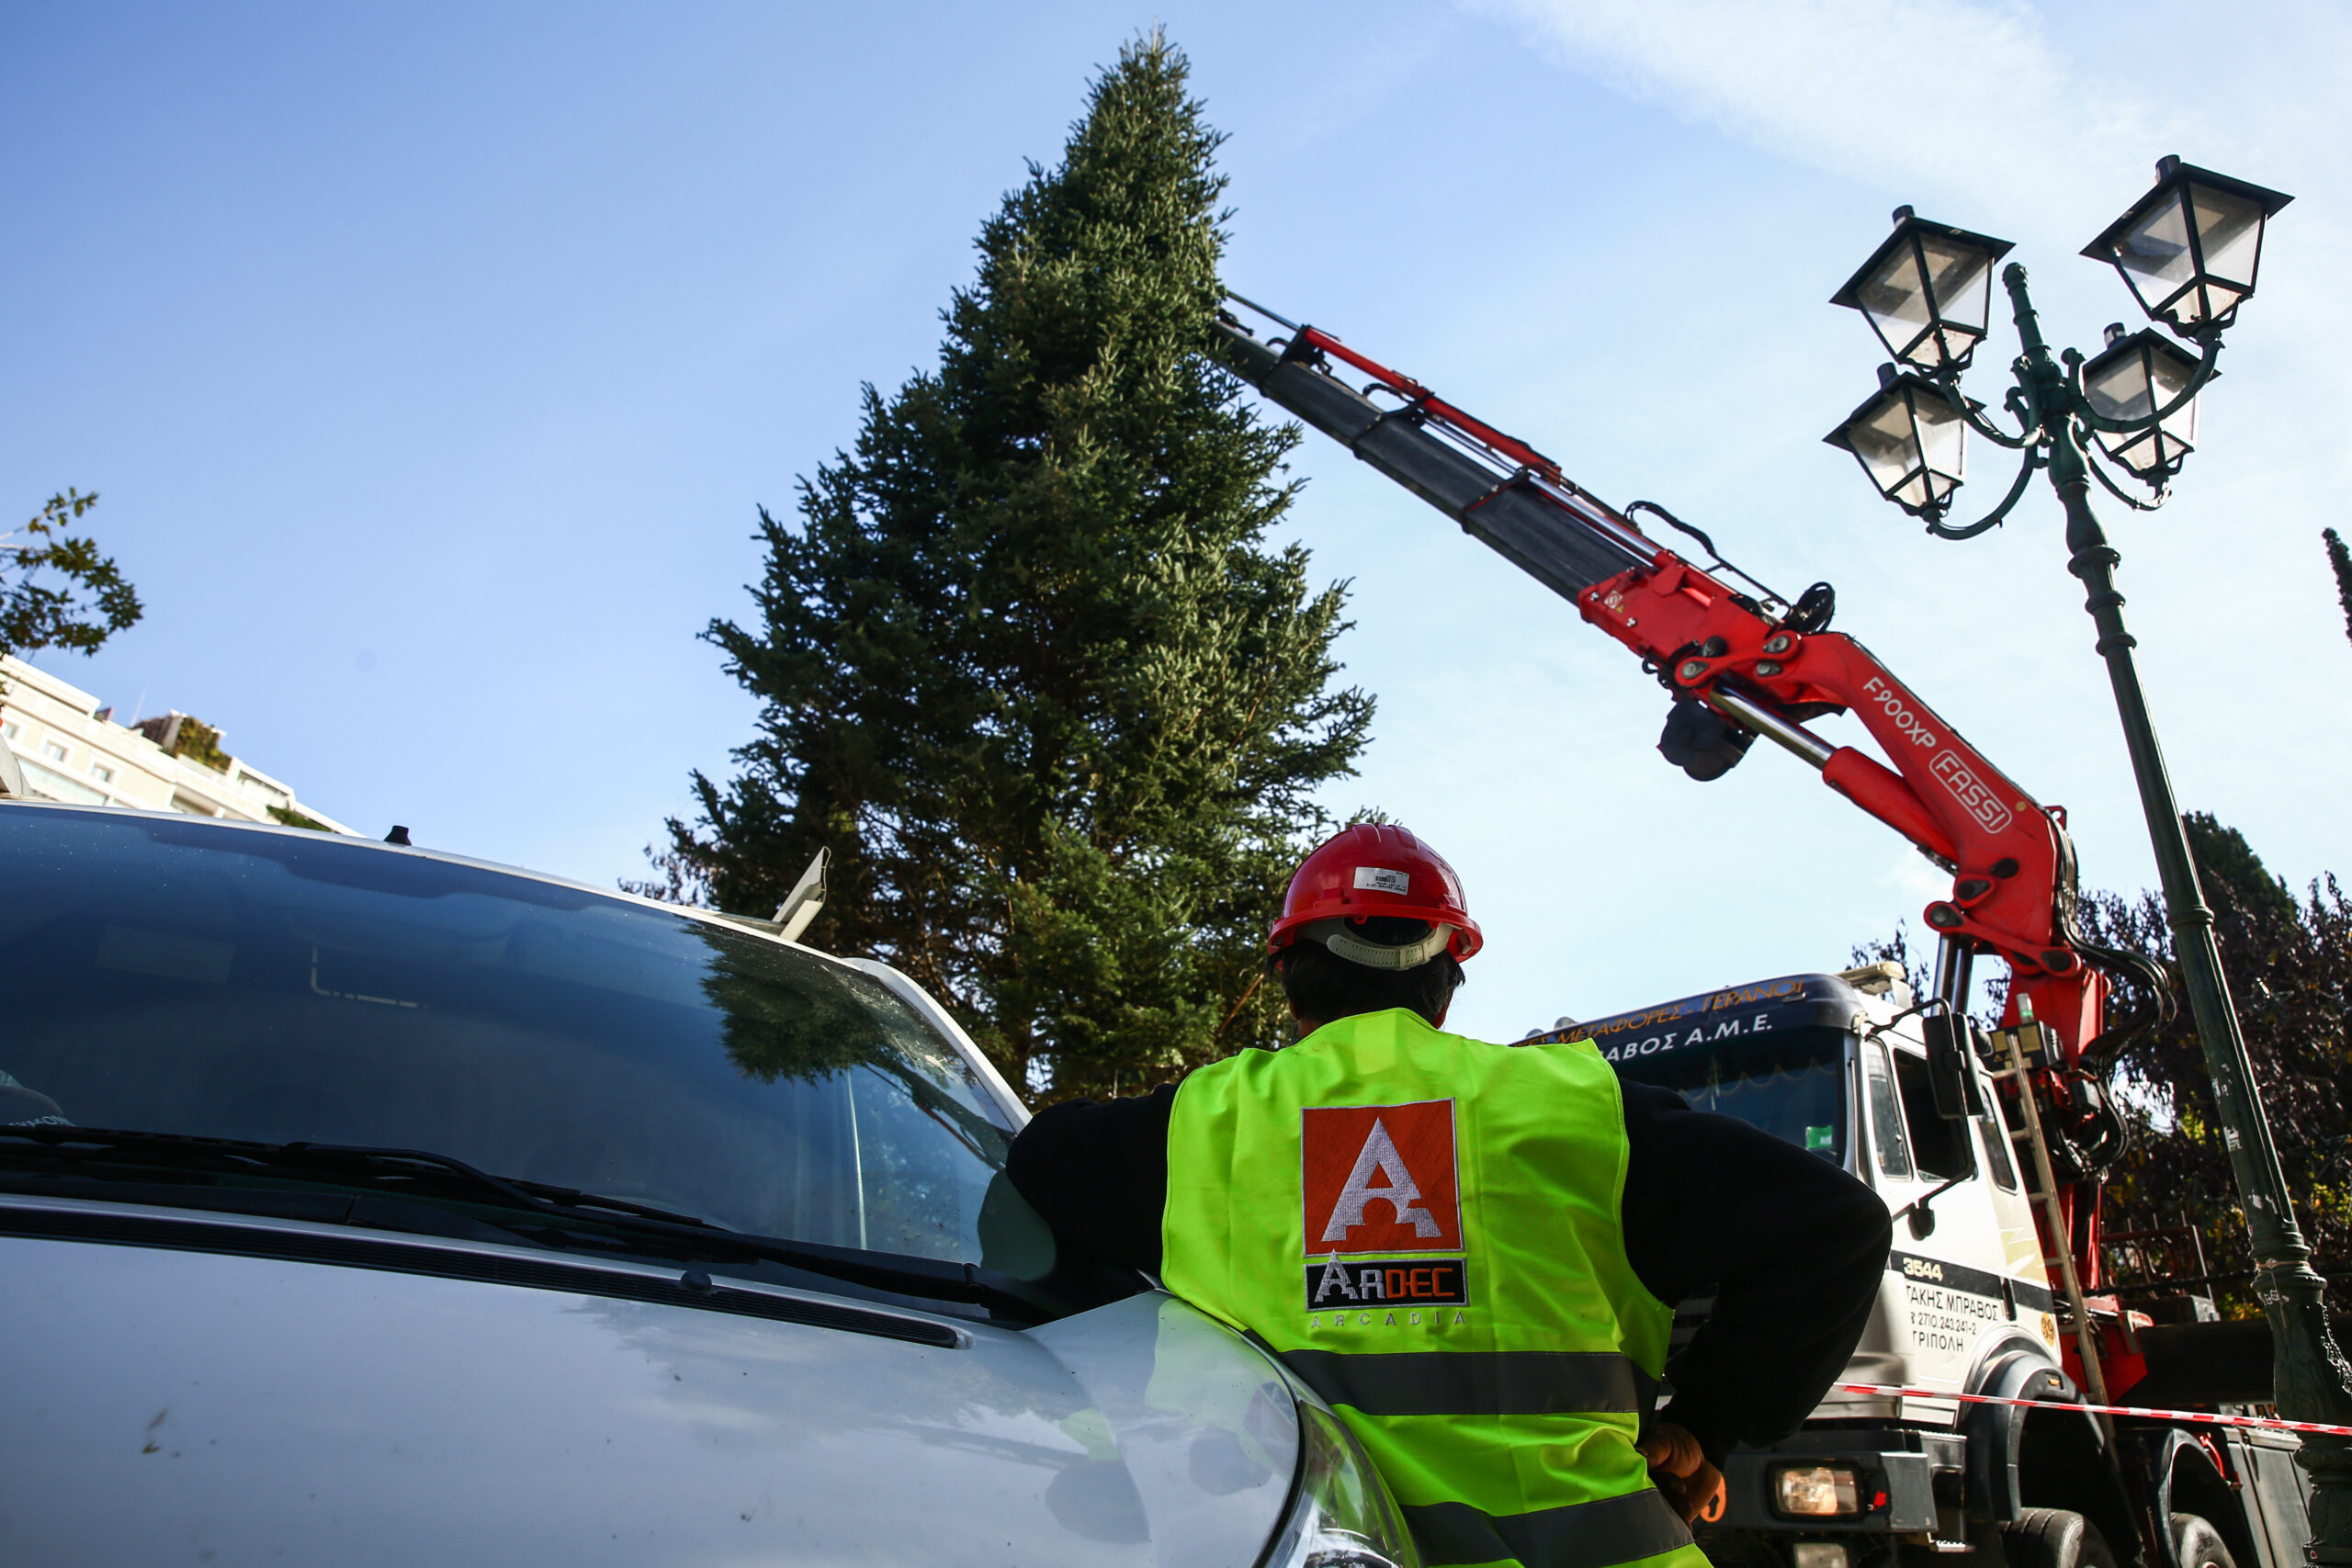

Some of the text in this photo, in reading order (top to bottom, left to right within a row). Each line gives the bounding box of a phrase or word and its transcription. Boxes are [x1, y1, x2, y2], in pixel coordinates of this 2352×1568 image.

[1862, 676, 1937, 748] F900XP
[1935, 756, 2006, 827] FASSI
[1556, 1002, 1686, 1044] ΜΕΤΑΦΟΡΕΣ
[1702, 978, 1804, 1012] ΓΕΡΑΝΟΙ
[1601, 1032, 1678, 1063] ΑΒΟΣ
[1903, 1257, 1943, 1281] 3544
[1311, 1311, 1465, 1329] ARCADIA
[1946, 1293, 1998, 1322] ΜΠΡΑΒΟΣ
[2041, 1316, 2055, 1340] 39
